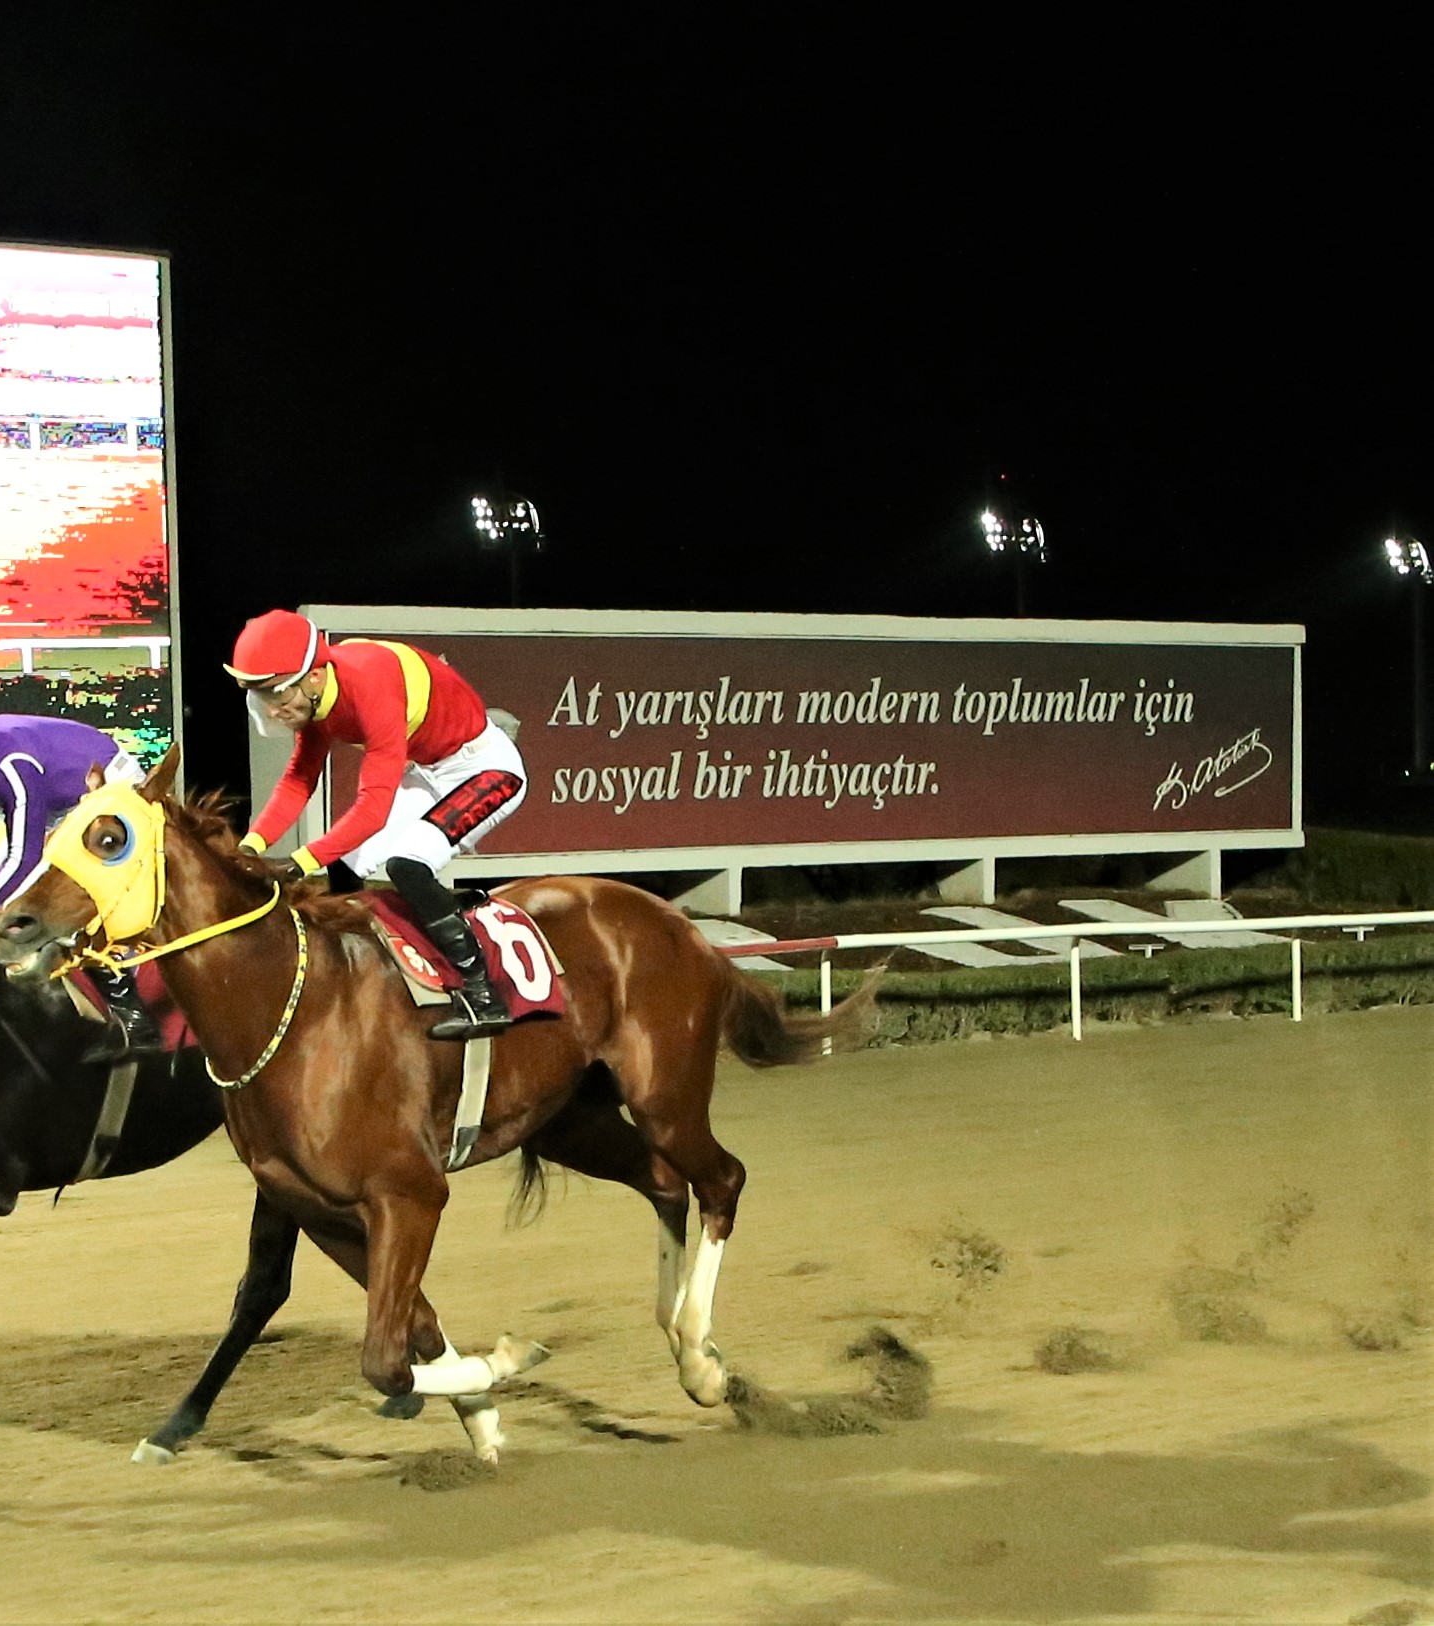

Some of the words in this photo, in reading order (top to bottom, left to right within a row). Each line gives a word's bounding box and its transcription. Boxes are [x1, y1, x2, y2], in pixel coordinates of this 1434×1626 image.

[546, 676, 603, 727] At
[608, 676, 785, 740] yarışları
[795, 676, 941, 726] modern
[951, 677, 1126, 736] toplumlar
[1132, 678, 1195, 737] için
[550, 750, 683, 815] sosyal
[692, 750, 753, 800] bir
[762, 748, 940, 810] ihtiyaçtır.
[475, 901, 553, 1002] 6
